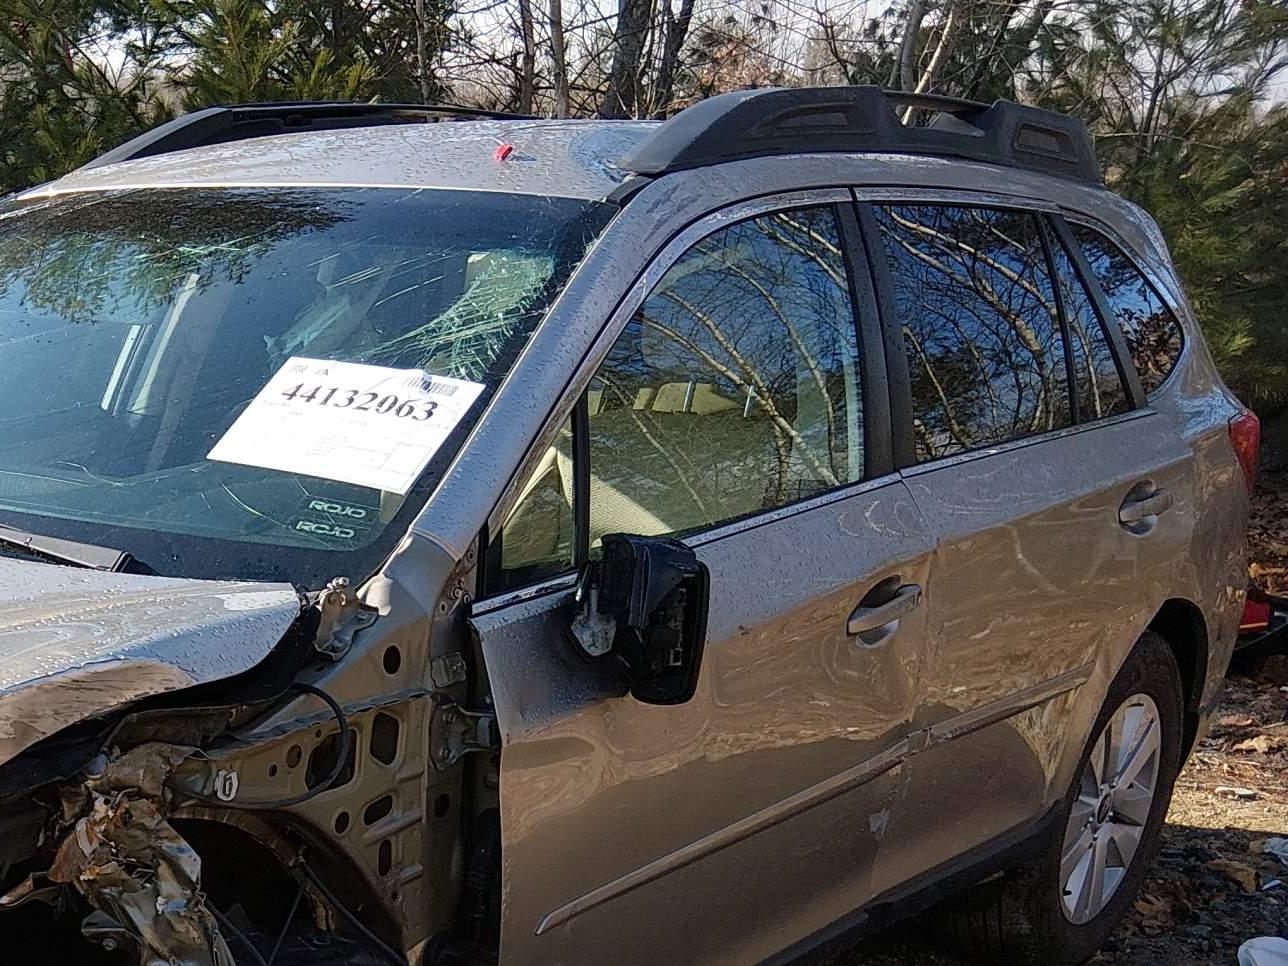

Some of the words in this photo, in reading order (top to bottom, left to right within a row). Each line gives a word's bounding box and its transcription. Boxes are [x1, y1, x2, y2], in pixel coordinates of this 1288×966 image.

[281, 382, 438, 421] 44132063
[308, 500, 367, 518] ROJO
[295, 520, 355, 538] ROJO
